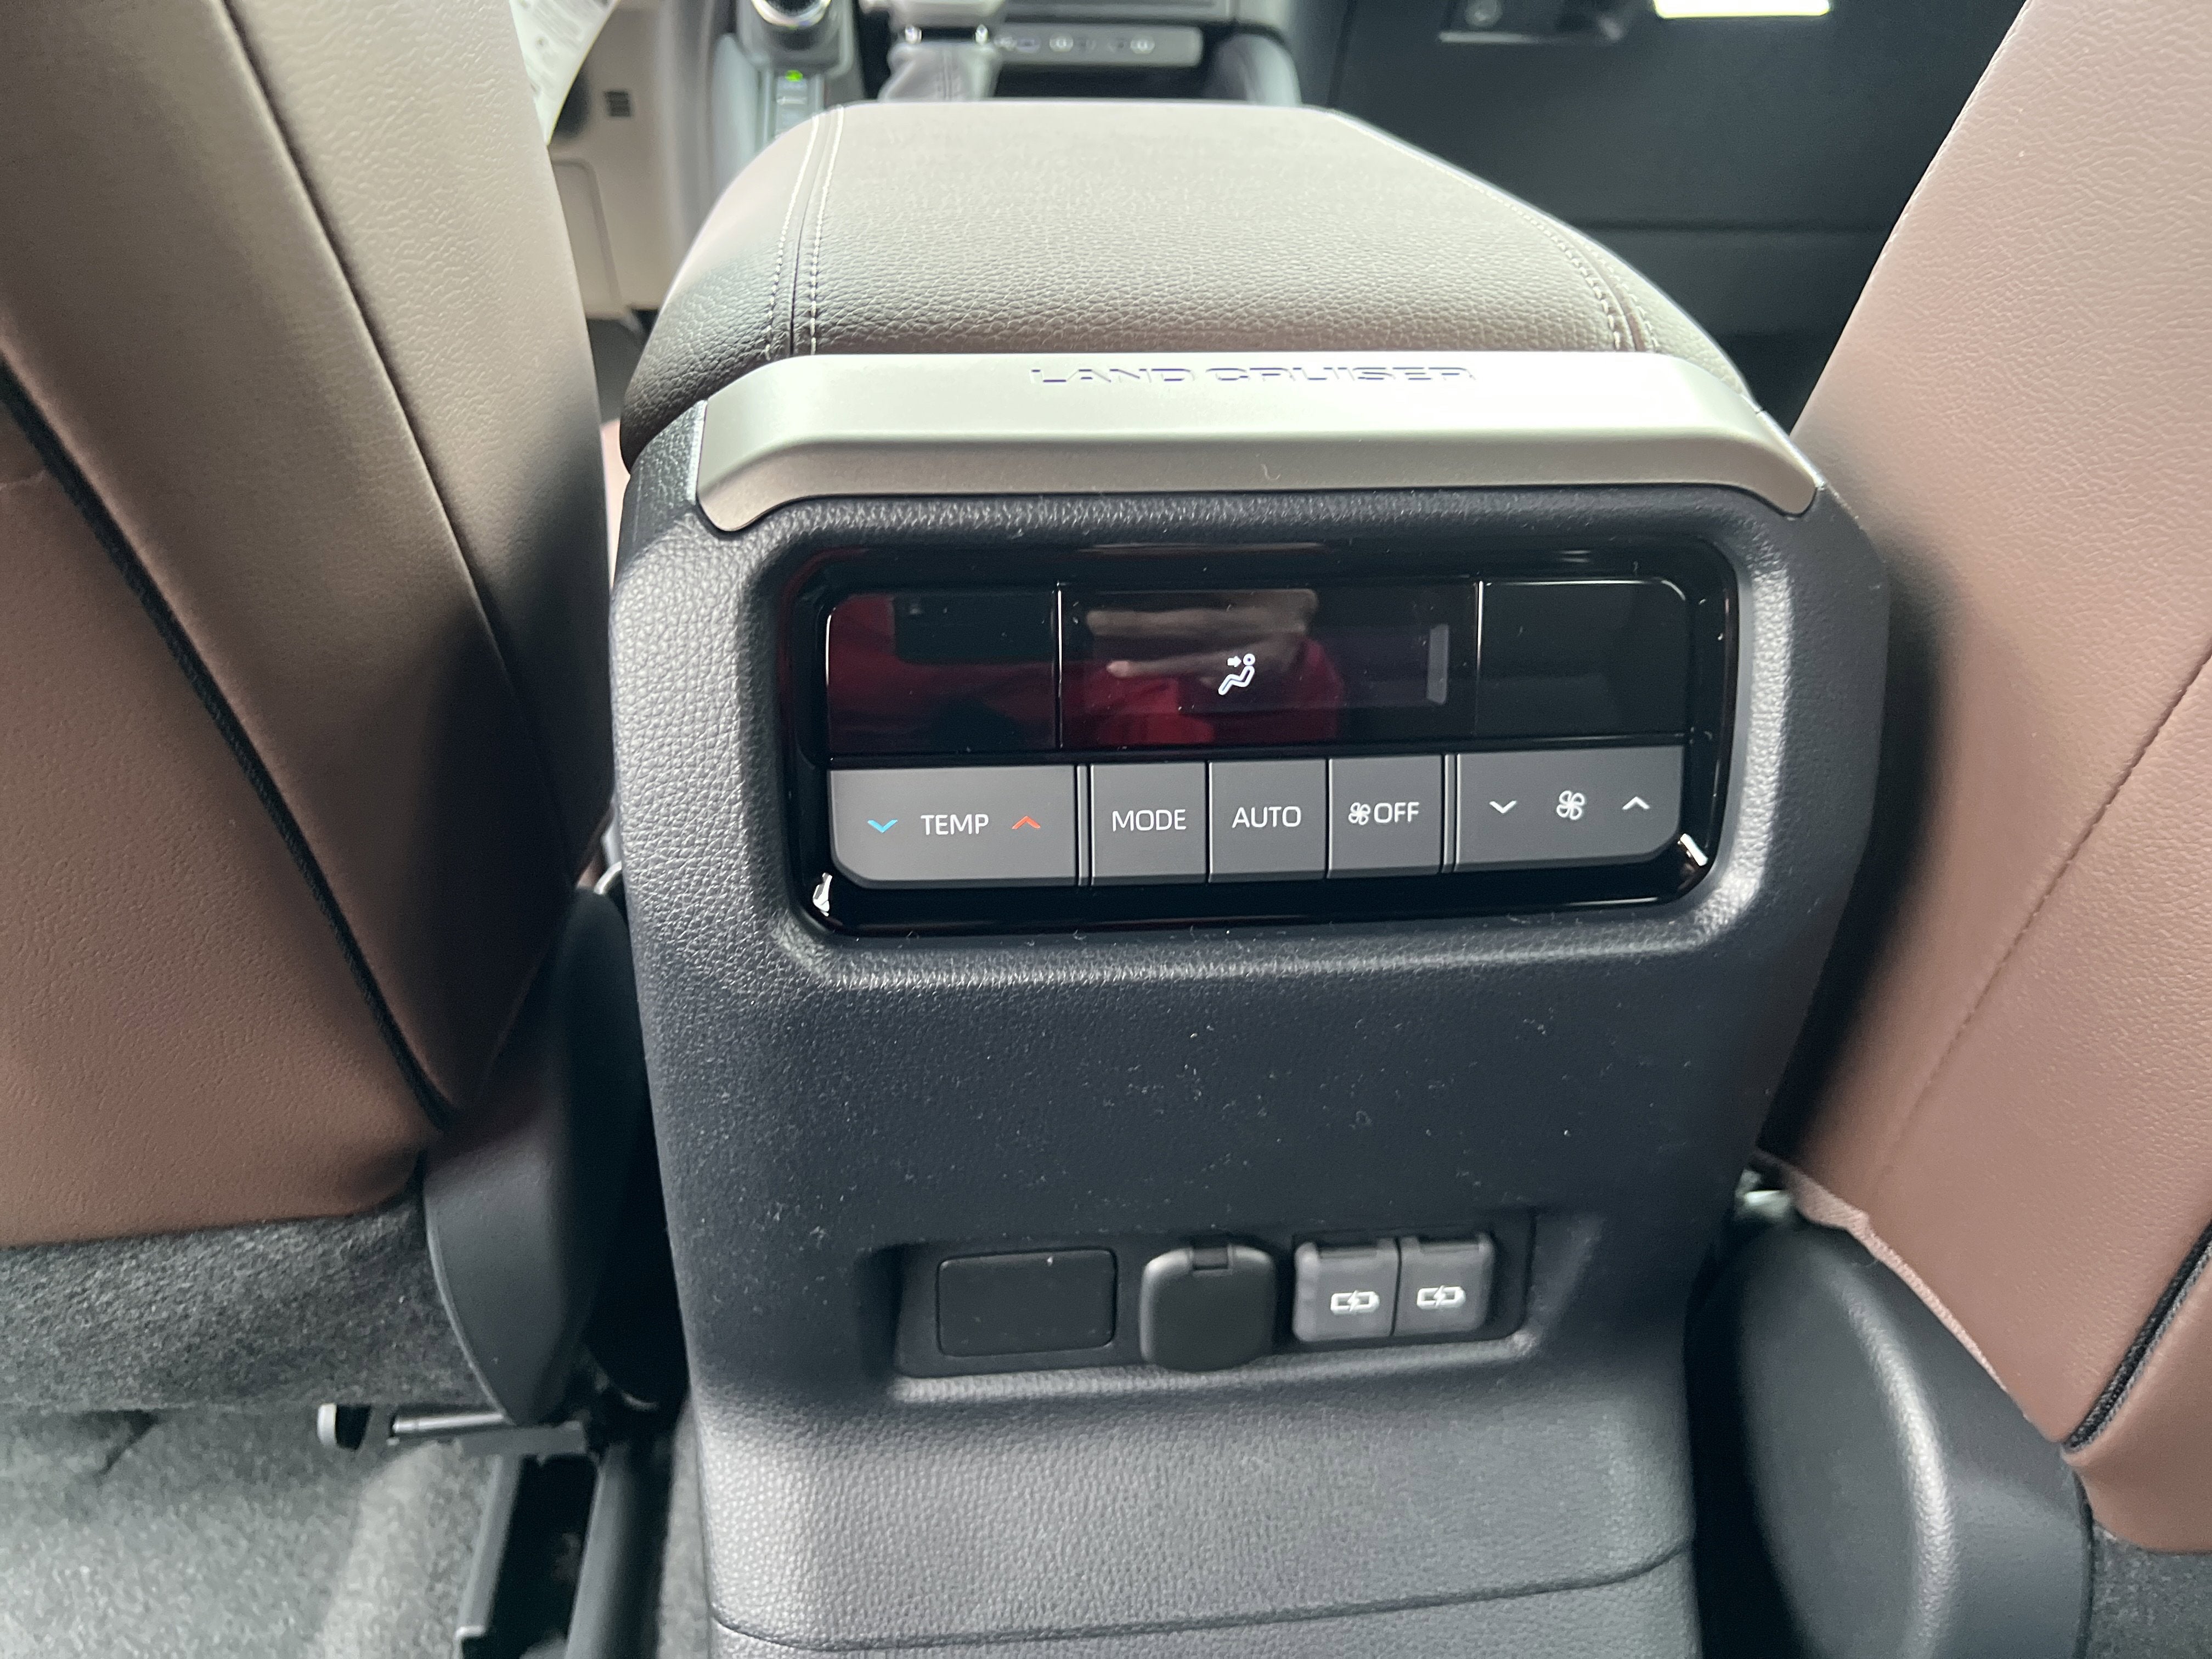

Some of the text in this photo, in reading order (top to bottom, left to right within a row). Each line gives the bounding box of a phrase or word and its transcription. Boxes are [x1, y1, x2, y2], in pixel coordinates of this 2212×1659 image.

[1029, 366, 1476, 383] LAND CRUISER
[1111, 809, 1187, 832] MODE
[1232, 805, 1302, 828] AUTO
[1373, 802, 1420, 823] OFF
[921, 814, 989, 836] TEMP
